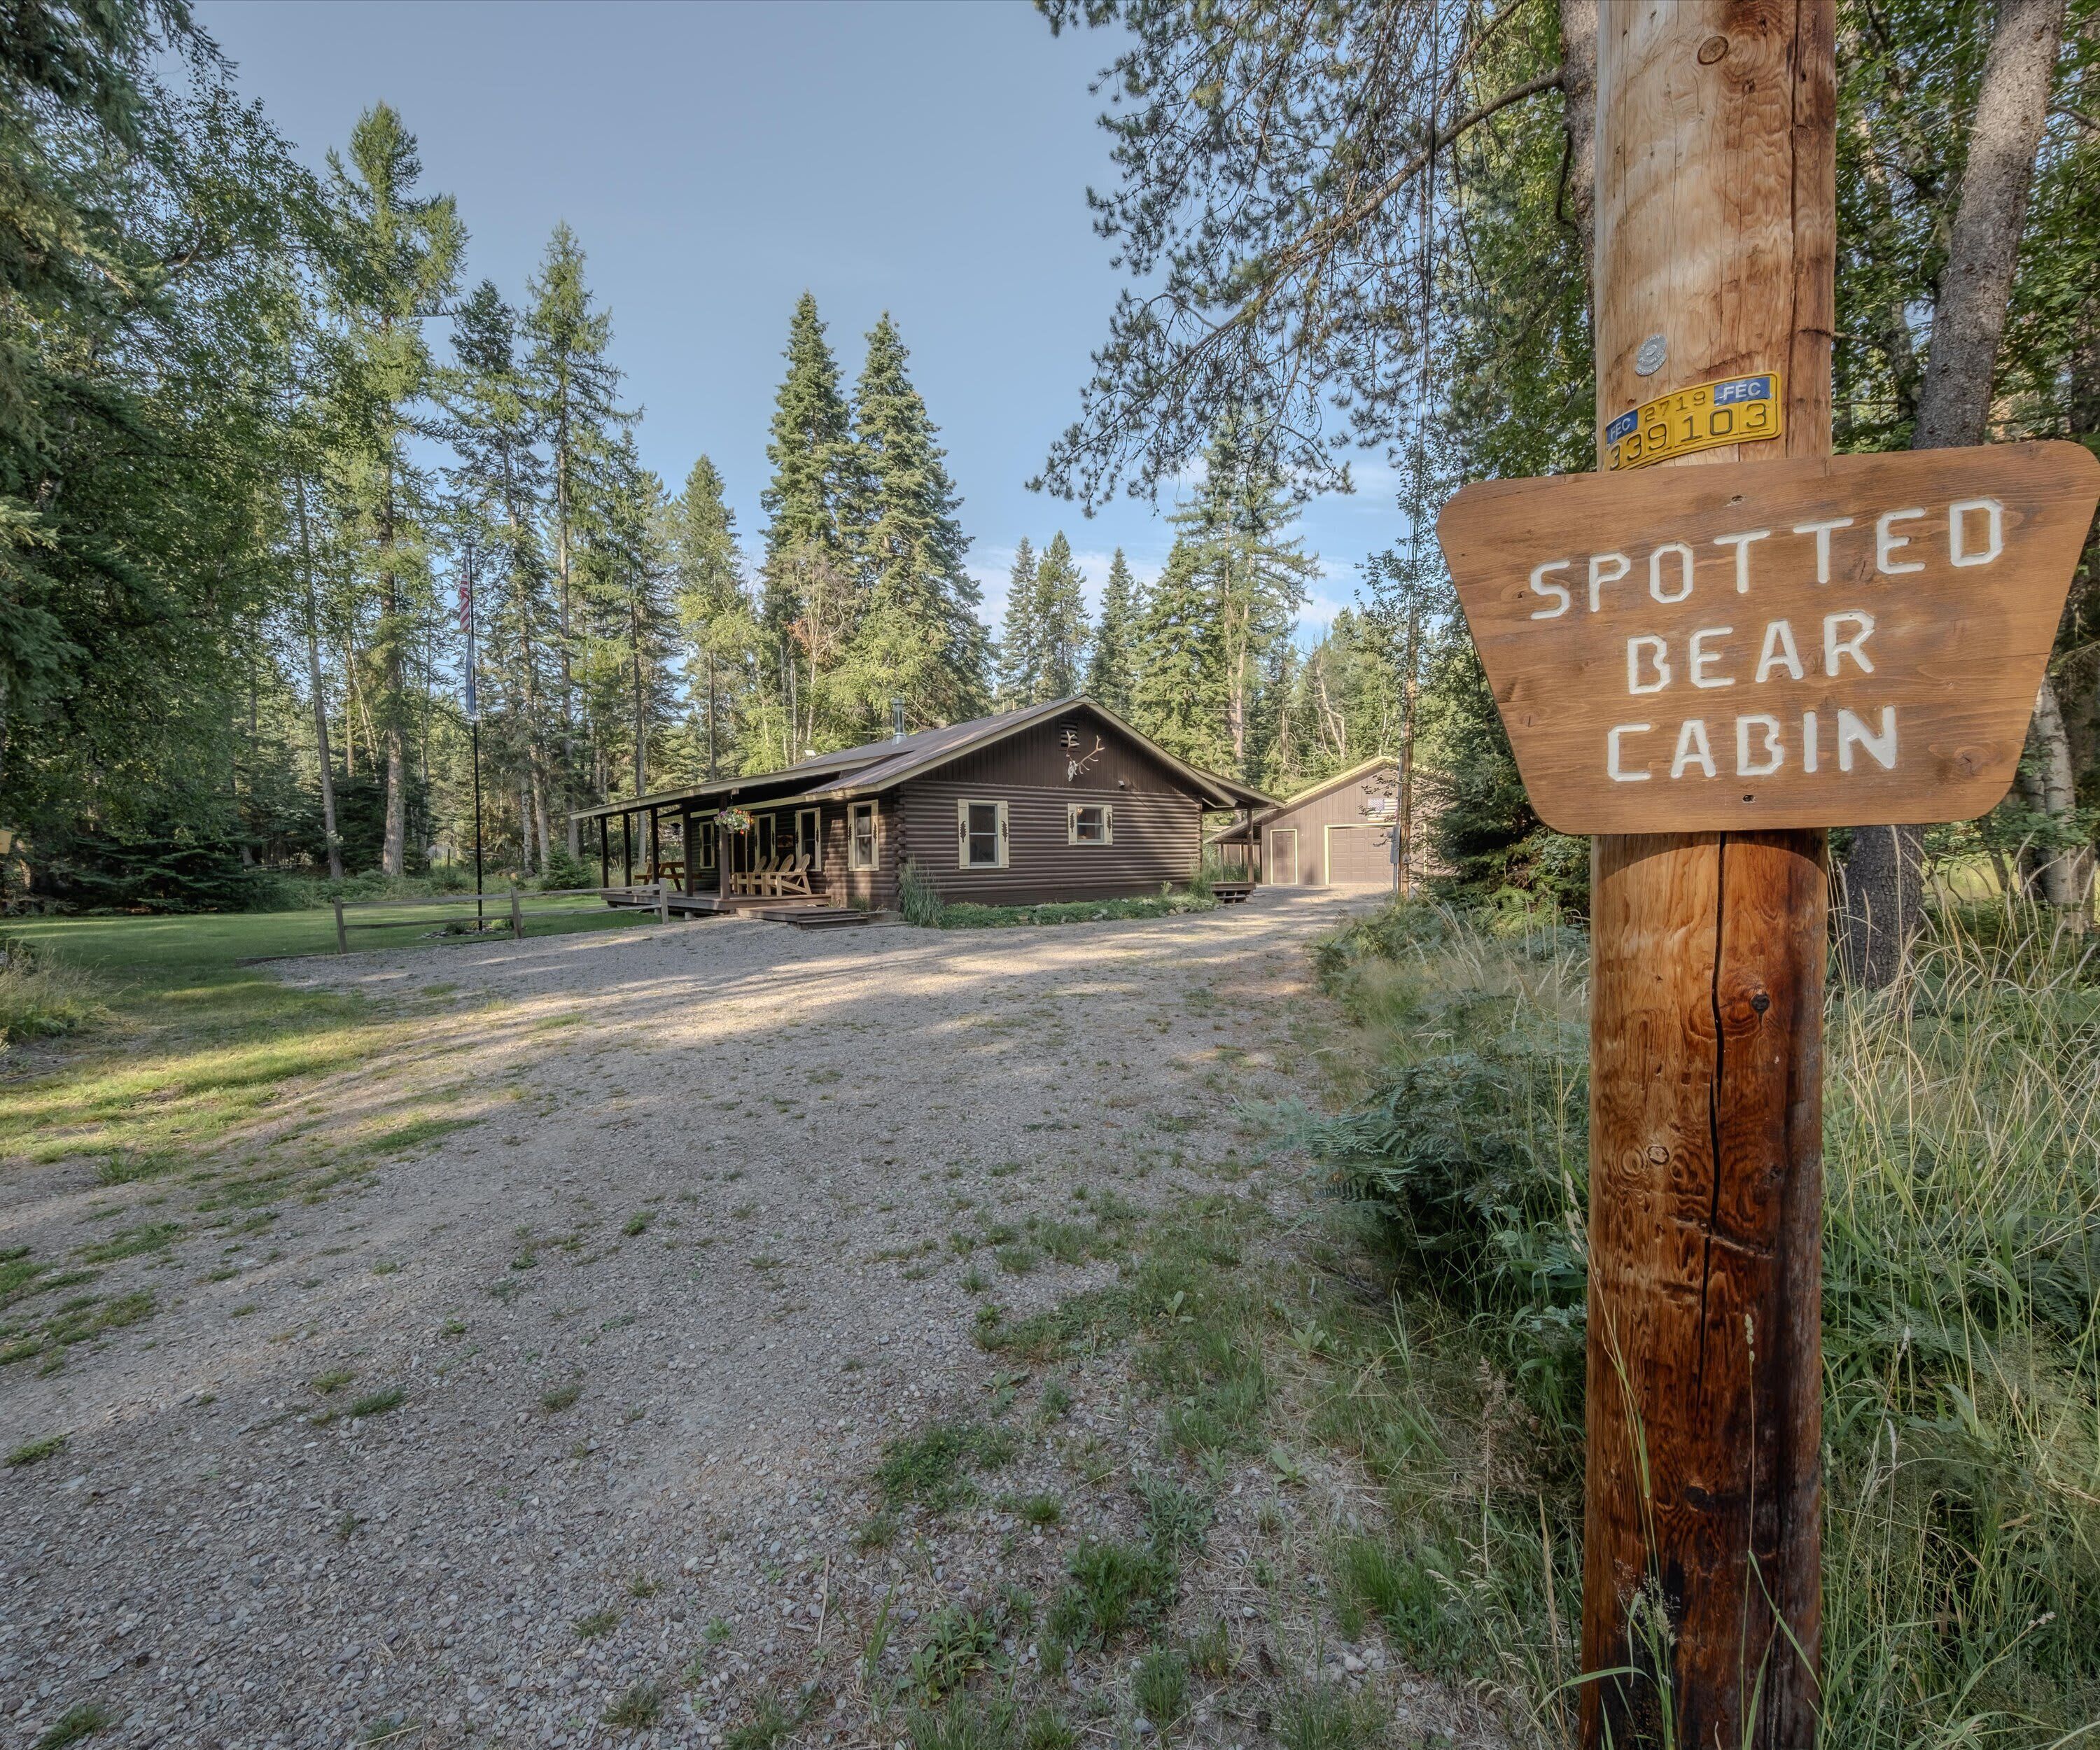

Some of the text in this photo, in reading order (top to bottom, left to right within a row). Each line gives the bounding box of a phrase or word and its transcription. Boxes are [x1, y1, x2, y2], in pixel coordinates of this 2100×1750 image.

[1610, 417, 1631, 441] FEC
[1723, 382, 1761, 400] FEC
[1529, 496, 2005, 621] SPOTTED
[1626, 608, 1877, 695] BEAR
[1606, 704, 1899, 783] CABIN
